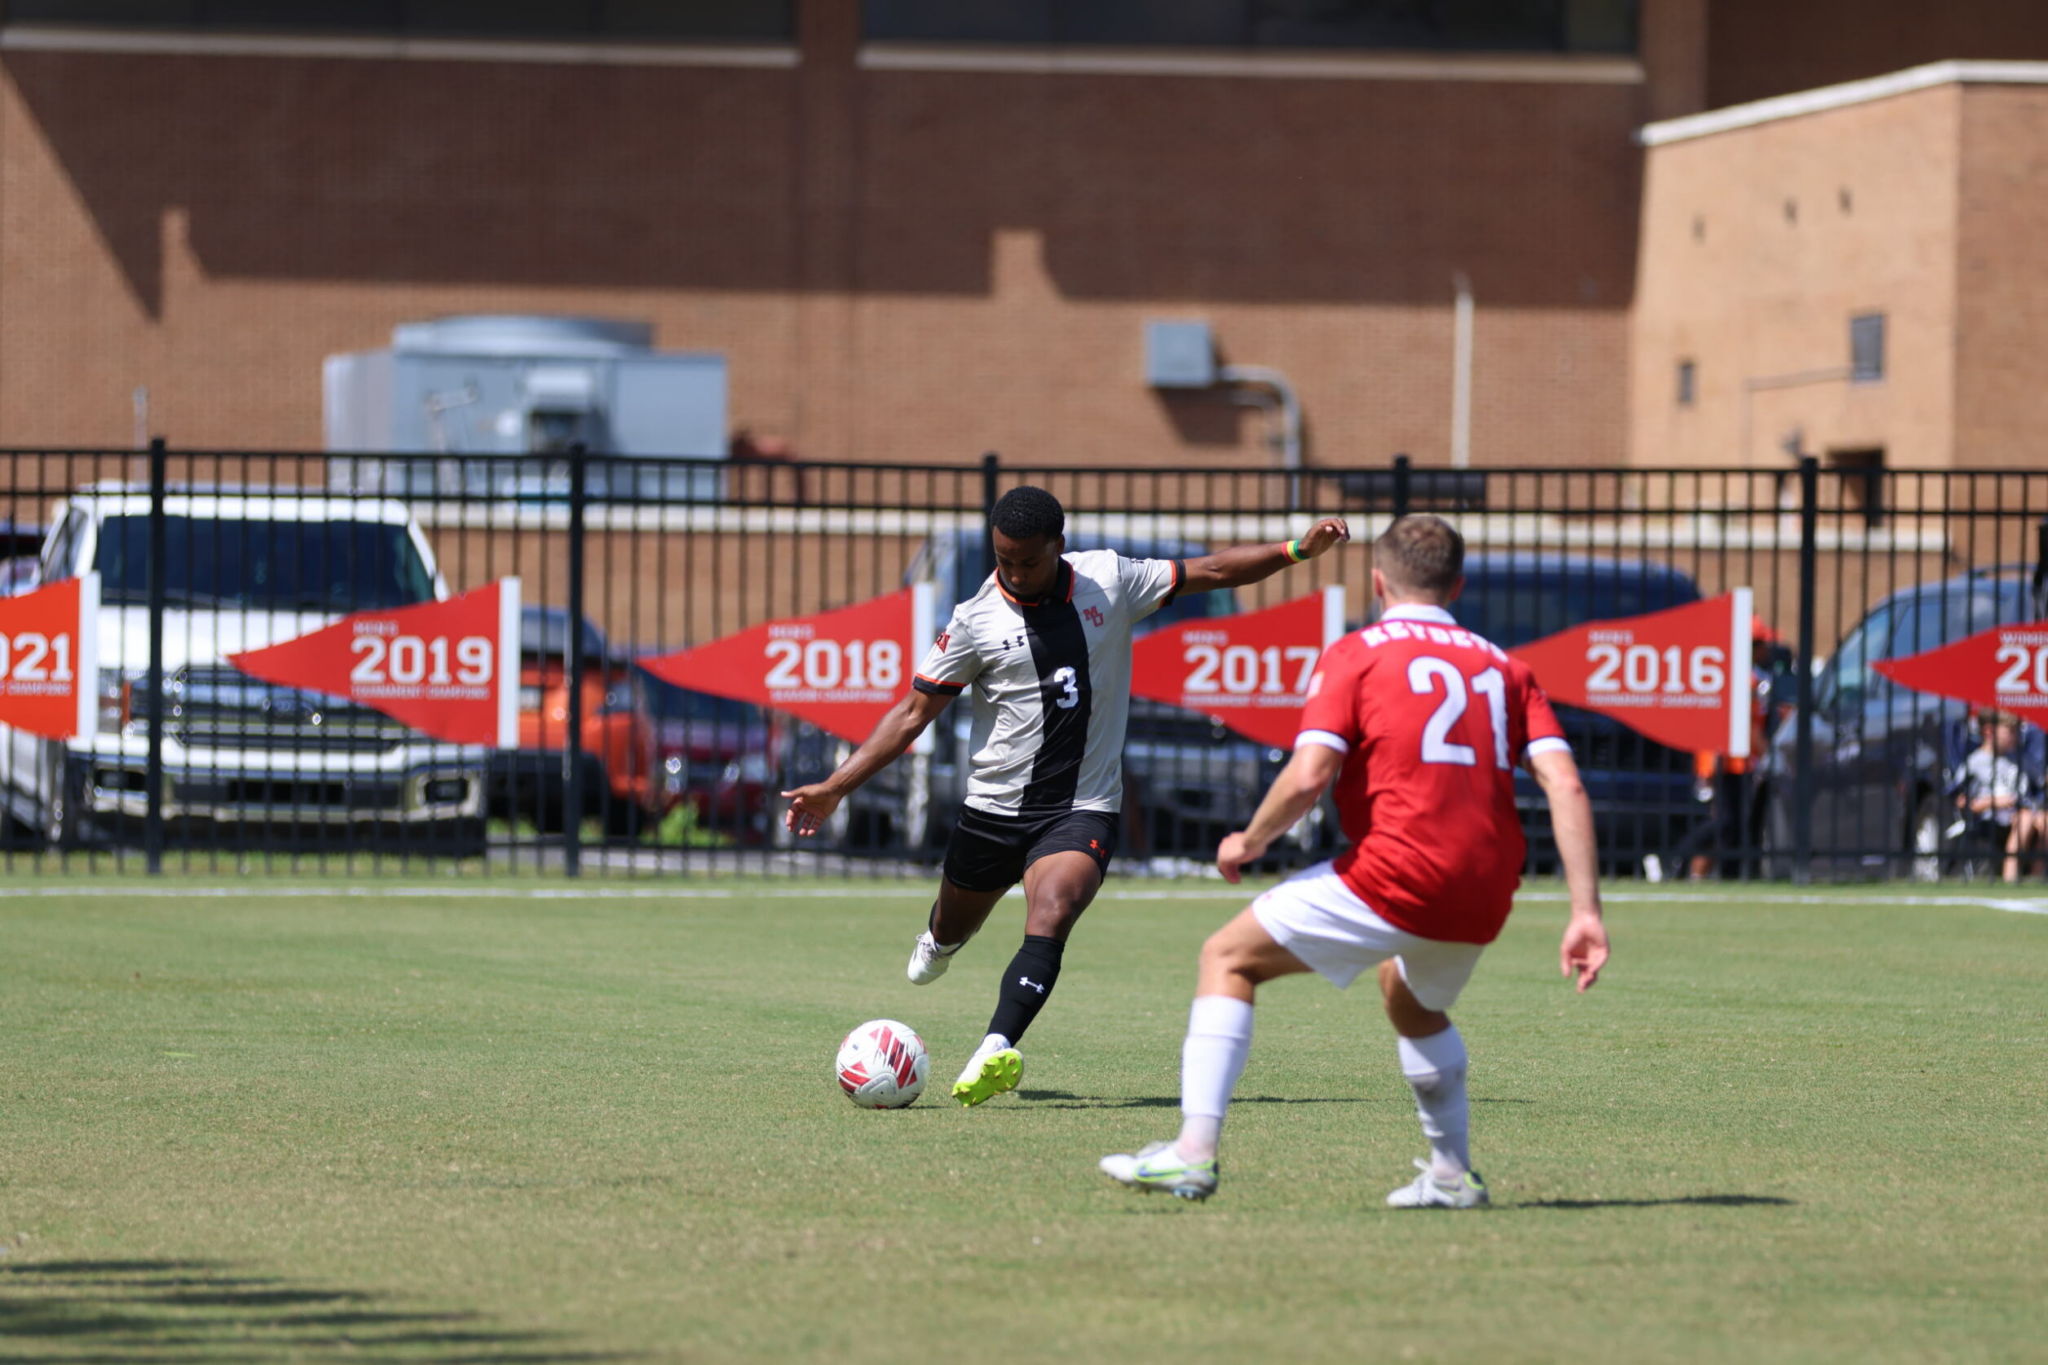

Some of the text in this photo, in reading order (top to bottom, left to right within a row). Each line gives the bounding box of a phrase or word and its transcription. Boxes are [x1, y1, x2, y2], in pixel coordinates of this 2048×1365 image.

[350, 635, 493, 686] 2019
[764, 639, 902, 690] 2018
[1182, 644, 1321, 695] 2017
[1585, 643, 1725, 694] 2016
[1054, 666, 1079, 709] 3
[1407, 655, 1511, 771] 21
